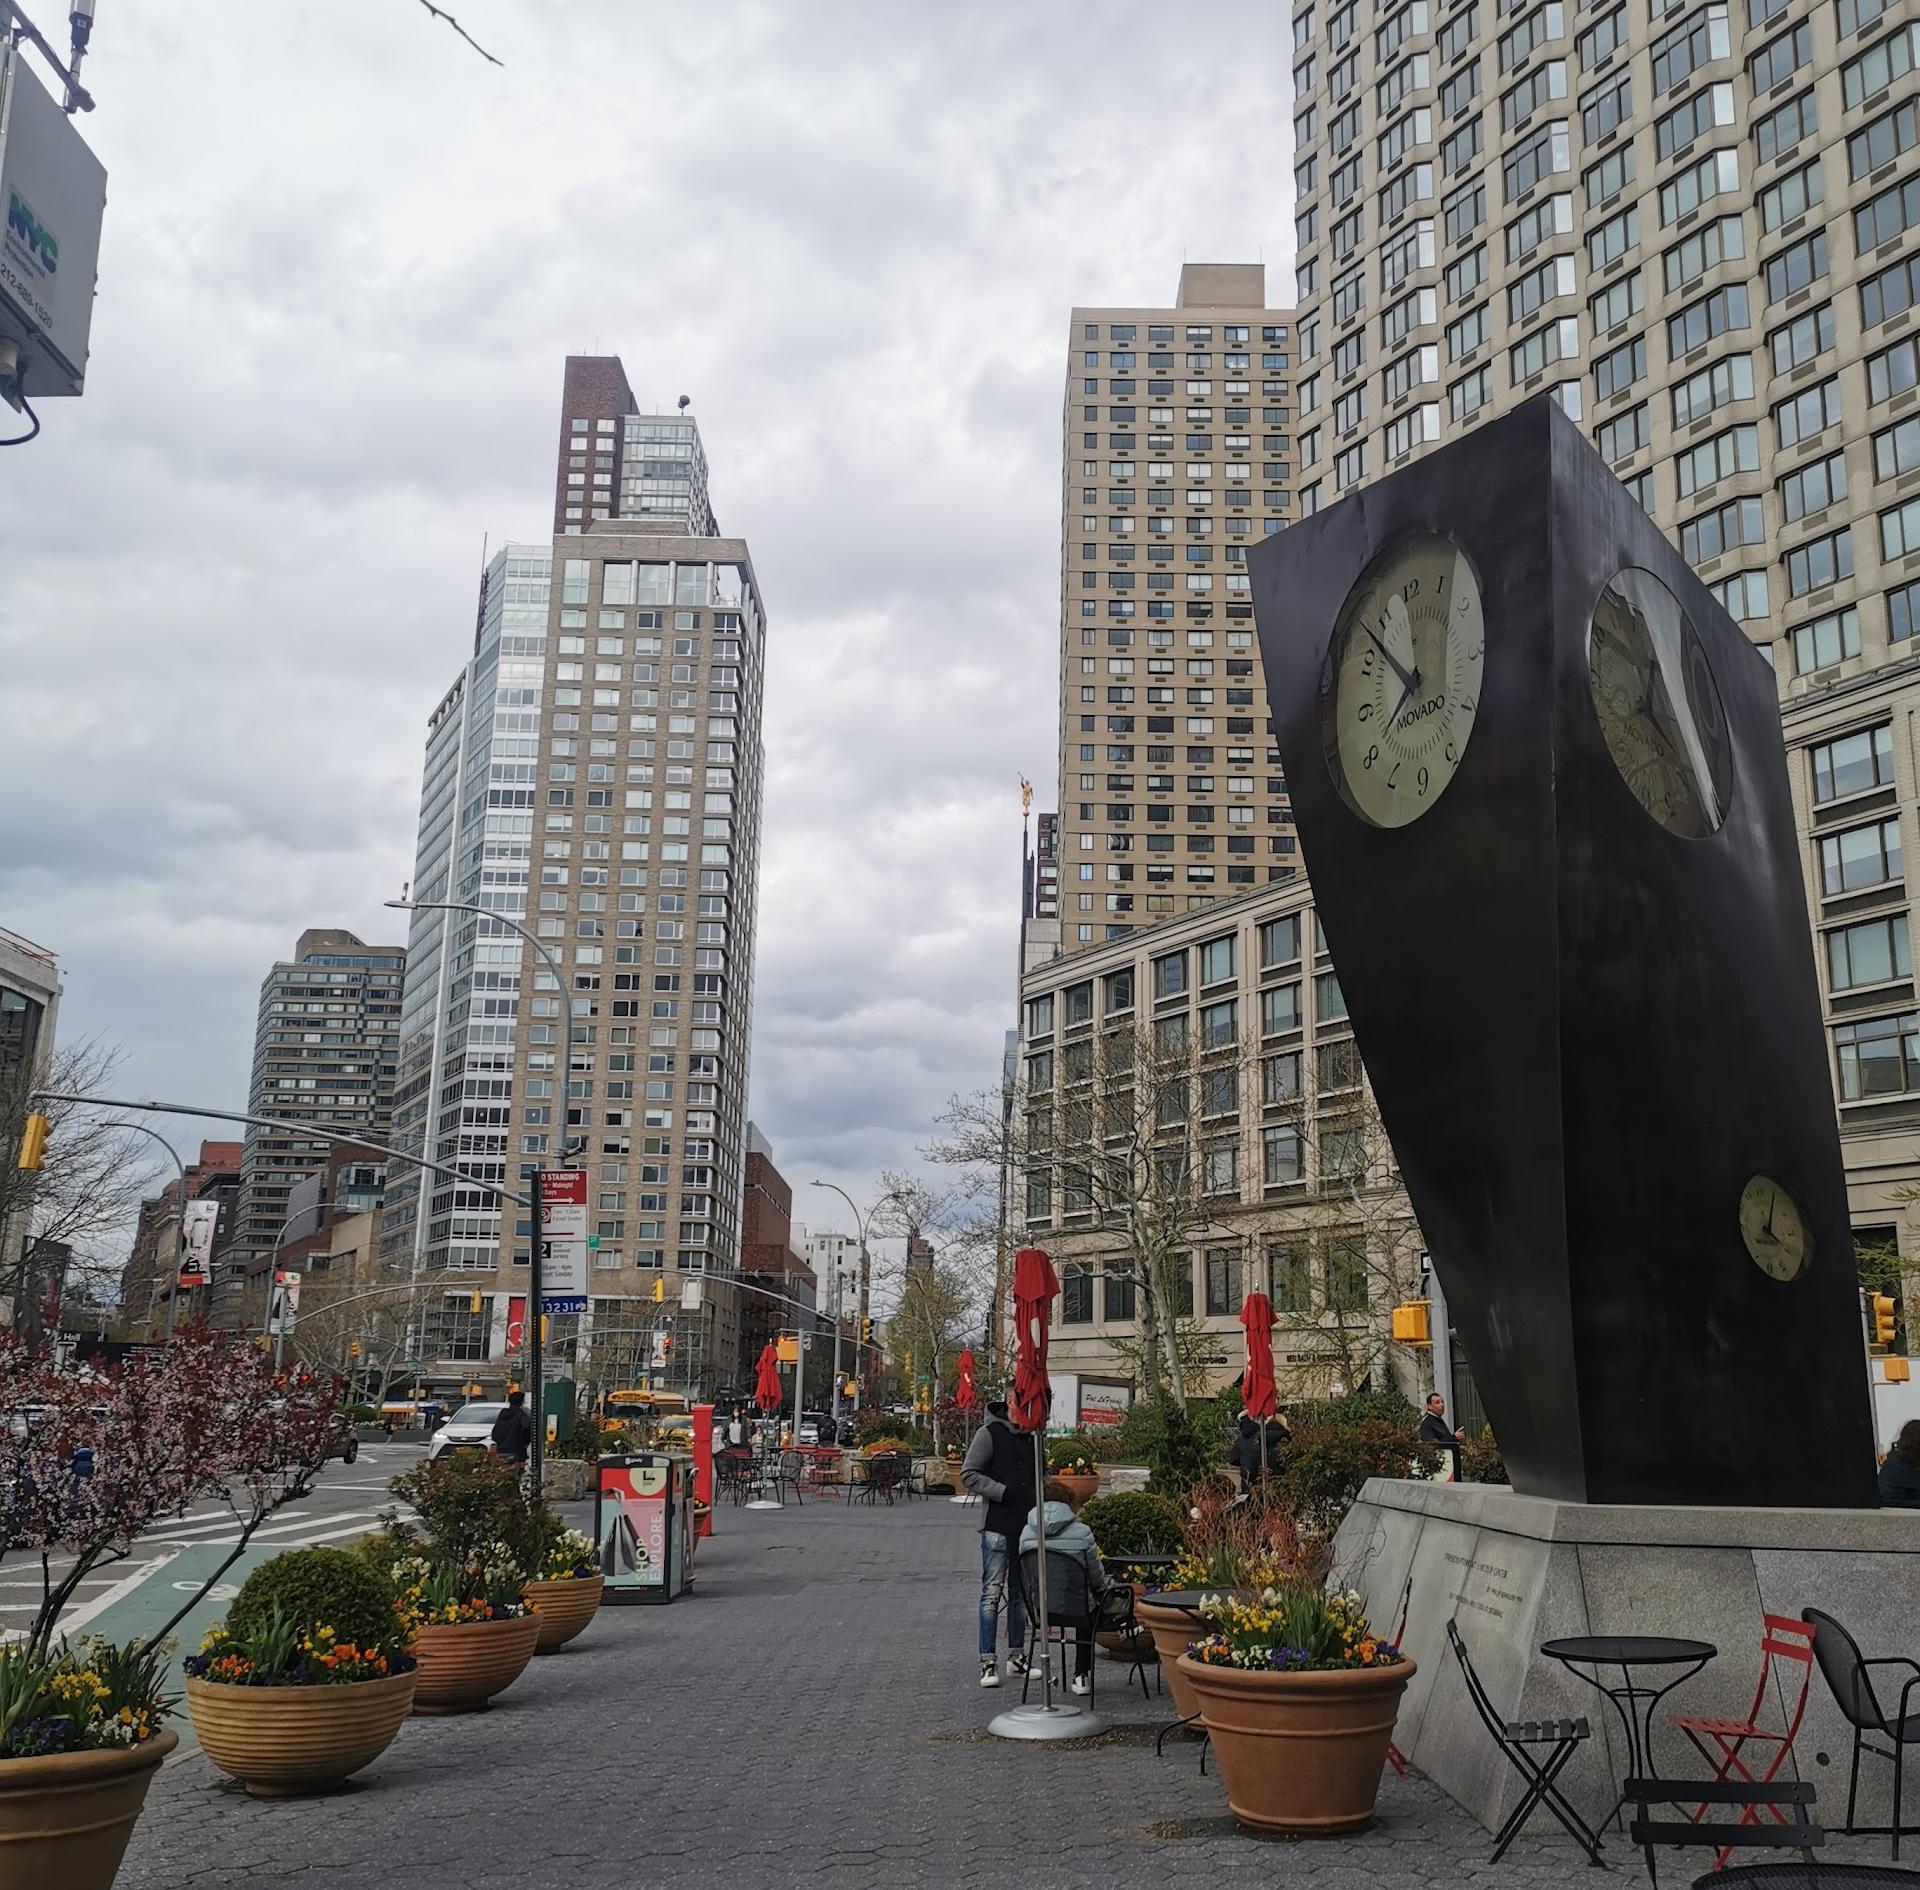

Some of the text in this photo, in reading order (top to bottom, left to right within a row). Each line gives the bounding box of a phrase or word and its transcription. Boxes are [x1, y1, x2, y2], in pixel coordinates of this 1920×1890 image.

[9, 192, 58, 274] NYC
[1402, 579, 1420, 603] 12
[1379, 607, 1392, 630] 11
[1457, 597, 1470, 618] 2
[1361, 648, 1375, 678] 10
[1357, 703, 1375, 723] 9
[1396, 694, 1446, 730] MOVADO
[1363, 745, 1379, 770] 8
[1387, 762, 1401, 790] 7
[1417, 767, 1429, 796] 6
[547, 1173, 580, 1181] STANDING
[188, 1247, 199, 1272] LIVE
[64, 1333, 81, 1341] Hall
[636, 1538, 649, 1582] SHOP
